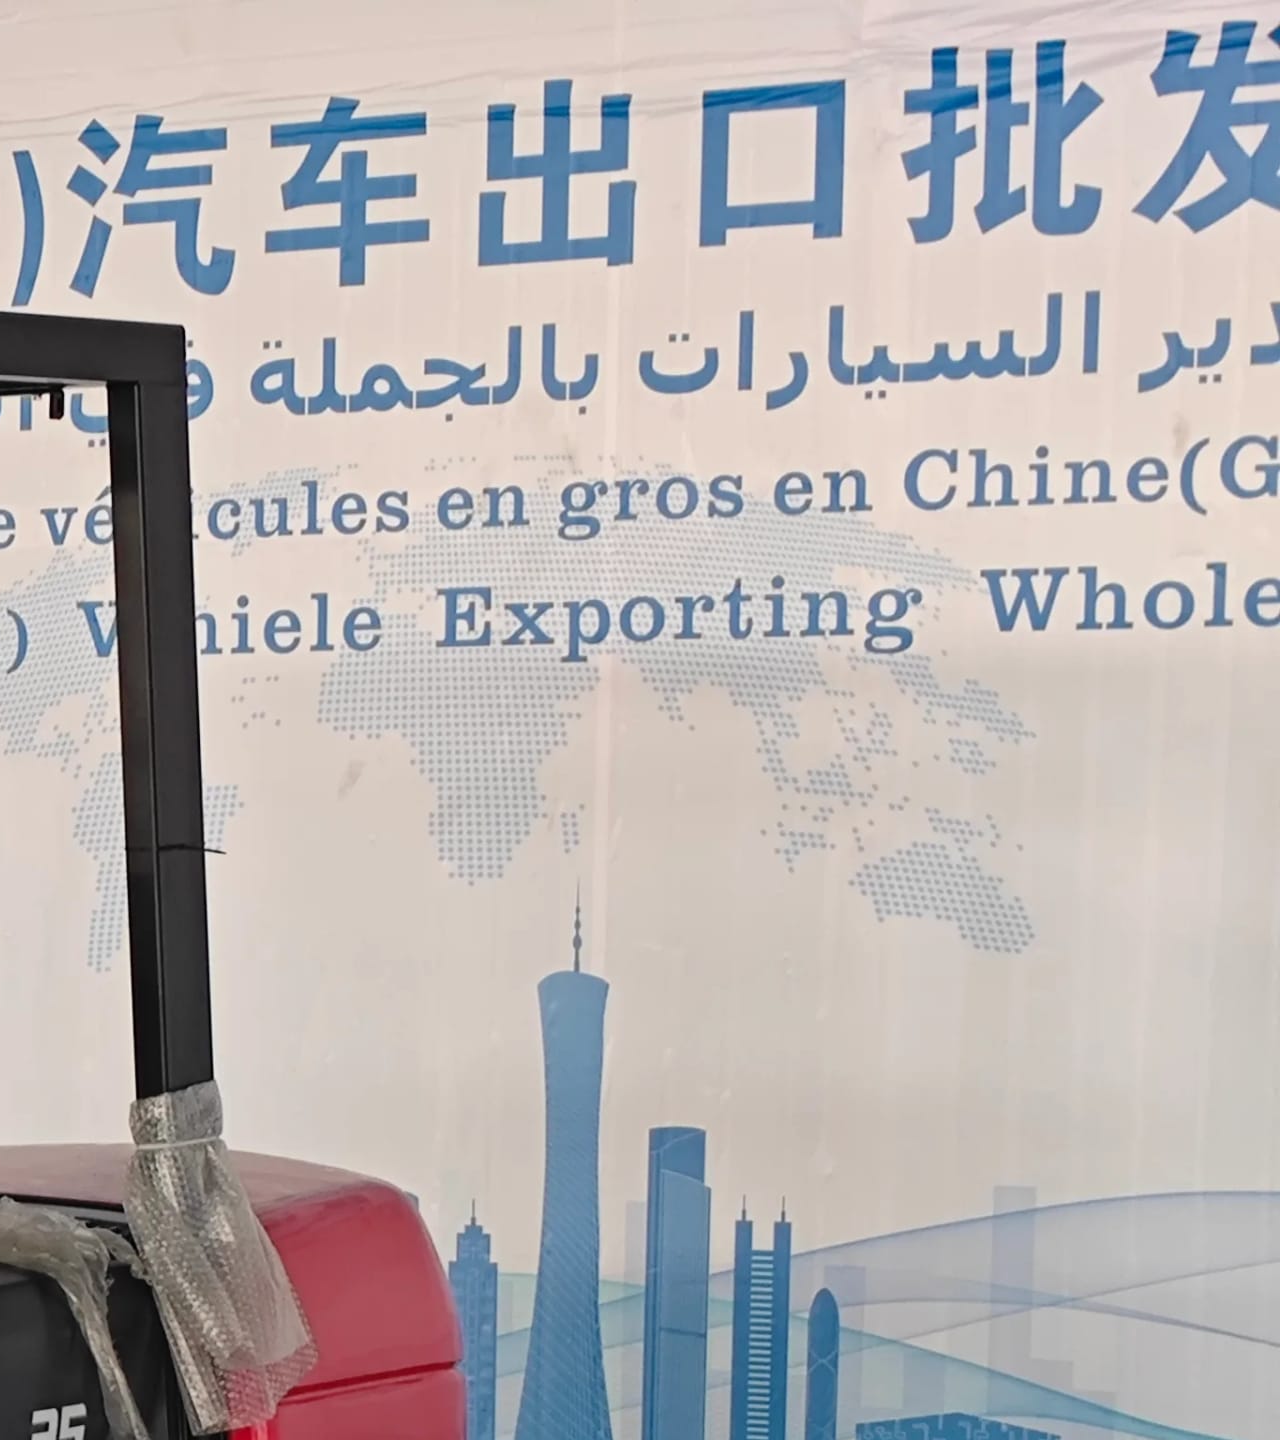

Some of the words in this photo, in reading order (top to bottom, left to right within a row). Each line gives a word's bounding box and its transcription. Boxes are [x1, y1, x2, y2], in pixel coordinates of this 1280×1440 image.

[250, 322, 599, 422] بالجملة
[638, 290, 1101, 410] السيارات
[41, 480, 410, 547] vécules
[435, 483, 530, 531] en
[557, 470, 744, 540] gros
[772, 467, 873, 517] en
[435, 574, 924, 663] Exporting
